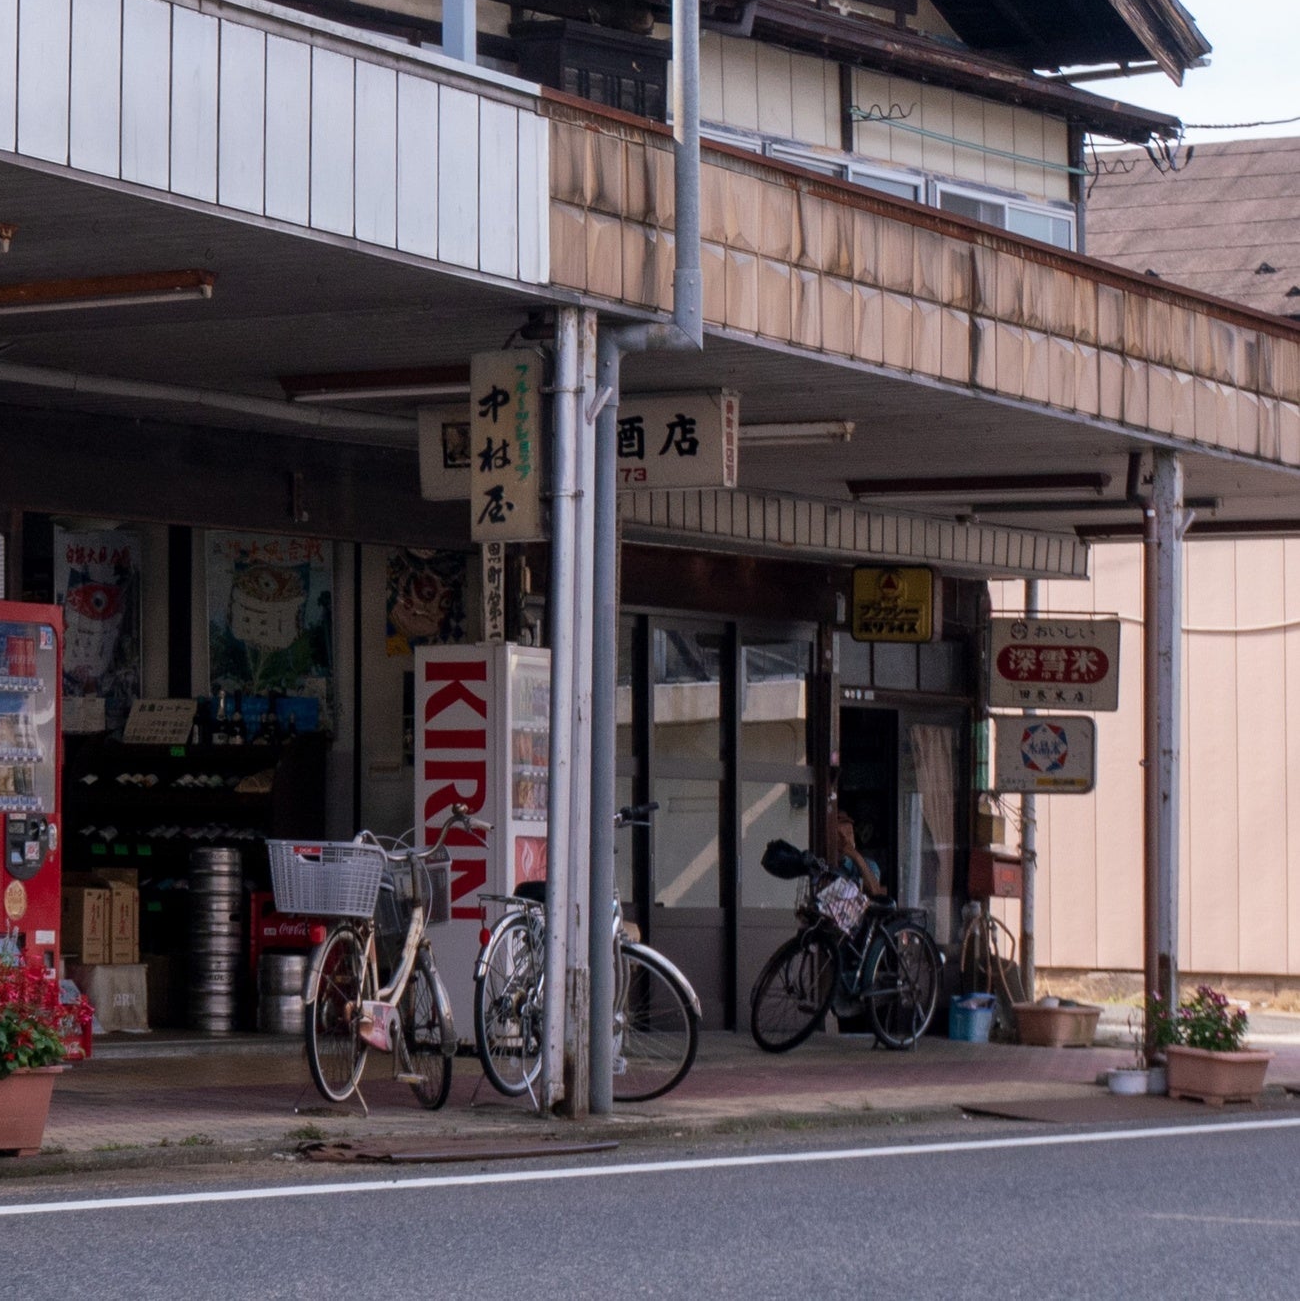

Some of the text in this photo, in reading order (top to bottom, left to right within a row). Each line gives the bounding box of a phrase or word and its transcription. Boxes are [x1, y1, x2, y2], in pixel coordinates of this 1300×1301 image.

[476, 384, 515, 526] 中村屋
[1033, 624, 1096, 640] おいしい
[424, 660, 487, 920] KIRIN
